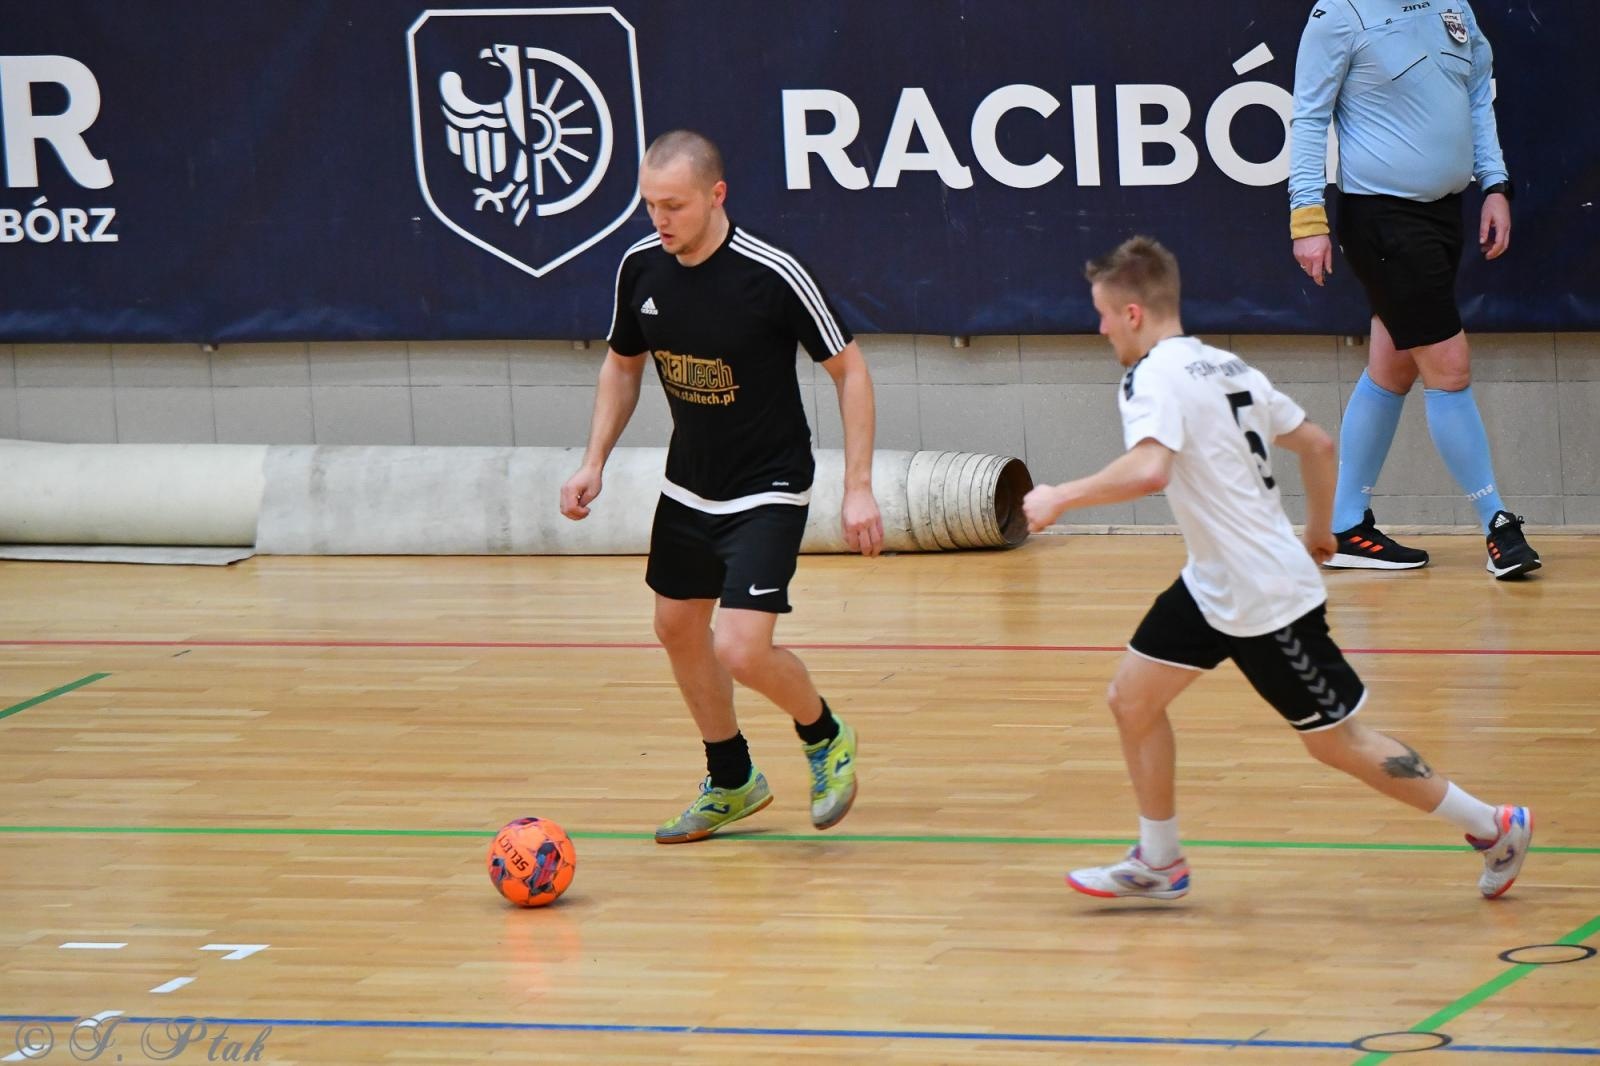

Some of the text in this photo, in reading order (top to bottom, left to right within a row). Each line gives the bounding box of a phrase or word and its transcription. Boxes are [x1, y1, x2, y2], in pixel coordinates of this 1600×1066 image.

[781, 42, 1497, 191] RACIBÓ
[0, 195, 119, 243] BÓRZ
[498, 834, 530, 872] SELECT
